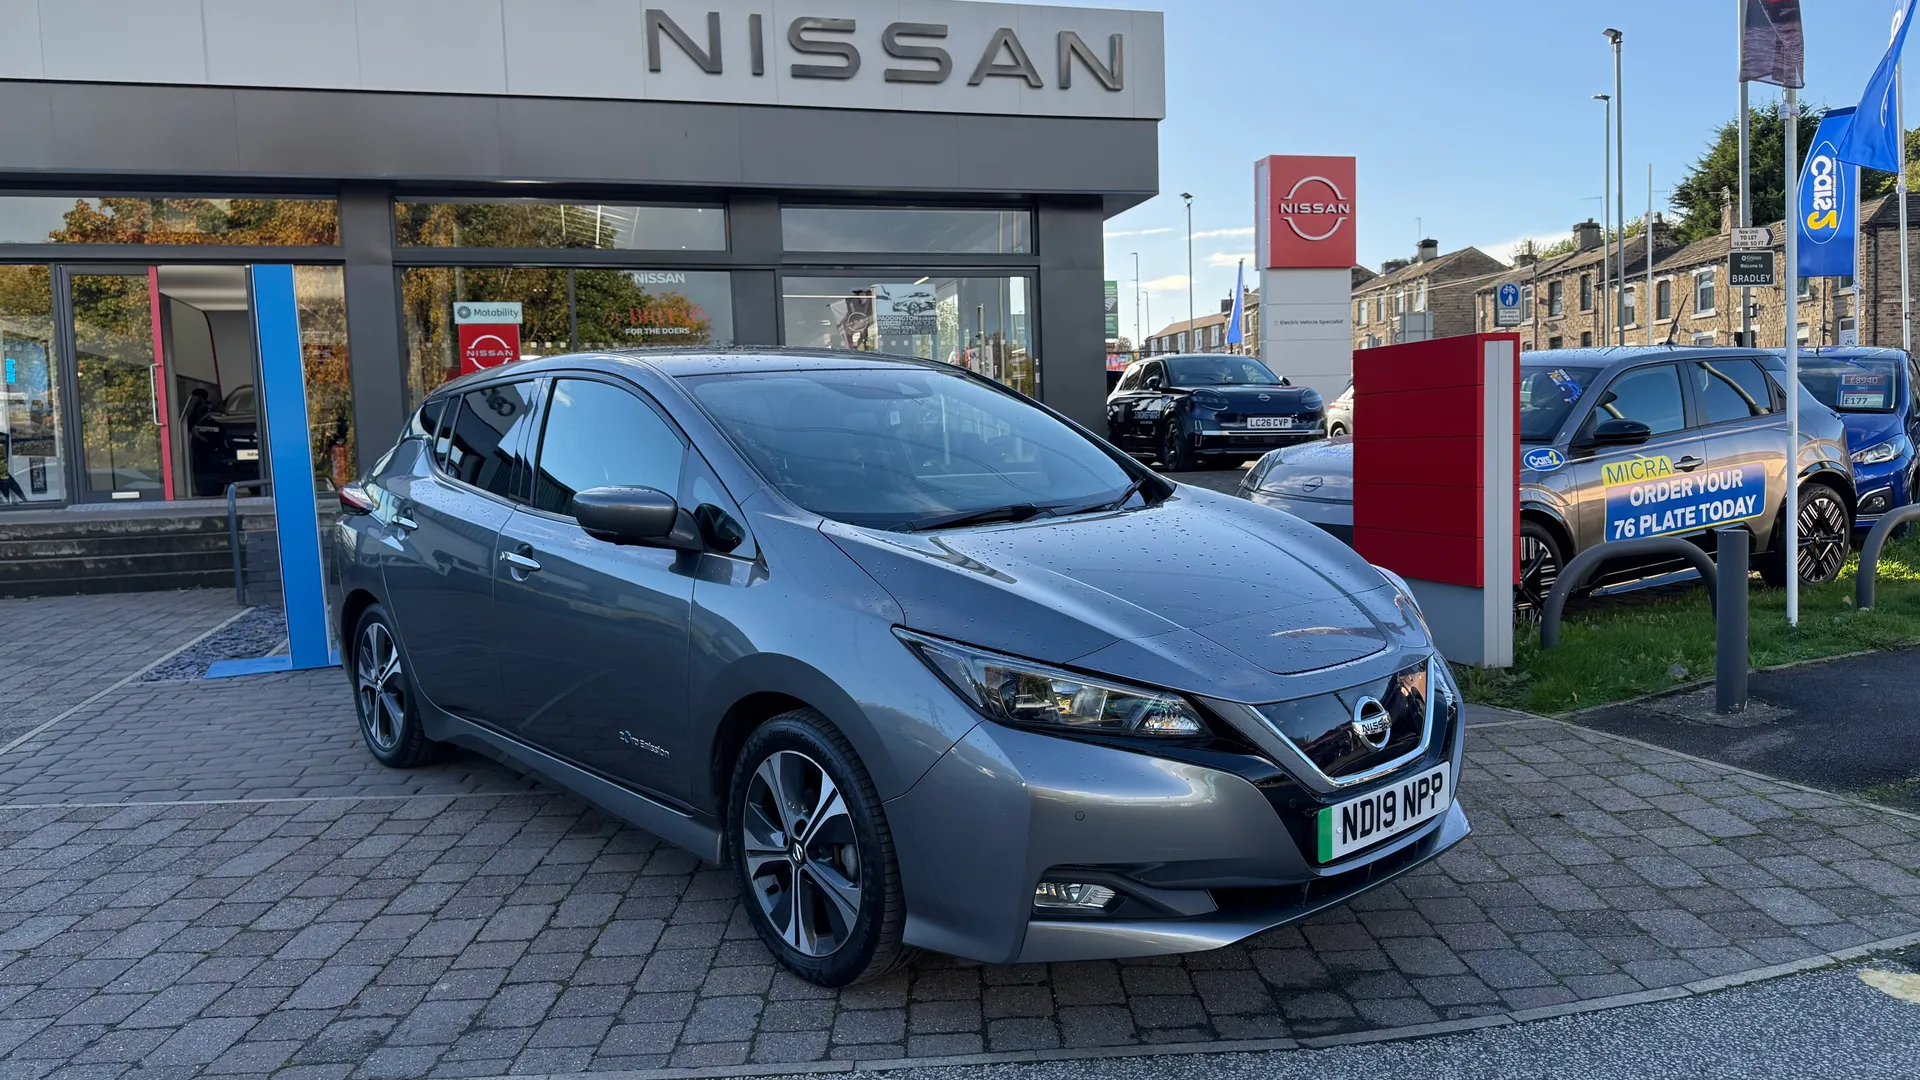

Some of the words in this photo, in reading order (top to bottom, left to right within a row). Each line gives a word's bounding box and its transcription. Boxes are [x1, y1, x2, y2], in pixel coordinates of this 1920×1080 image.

[645, 9, 1123, 92] NISSAN
[1280, 203, 1350, 214] NISSAN
[634, 273, 685, 283] NISSAN
[1732, 274, 1771, 283] BRADLEY
[474, 308, 519, 319] Motability
[662, 327, 690, 335] DOERS
[1250, 419, 1272, 427] LC26
[1272, 419, 1288, 427] CVP
[1529, 451, 1560, 466] Cars2
[1606, 458, 1671, 484] MICRA
[1630, 477, 1693, 507] ORDER
[1695, 469, 1743, 494] YOUR
[1614, 518, 1636, 540] 76
[1639, 506, 1697, 535] PLATE
[1699, 494, 1757, 523] TODAY
[1342, 790, 1397, 845] ND19
[1403, 771, 1443, 821] NPP
